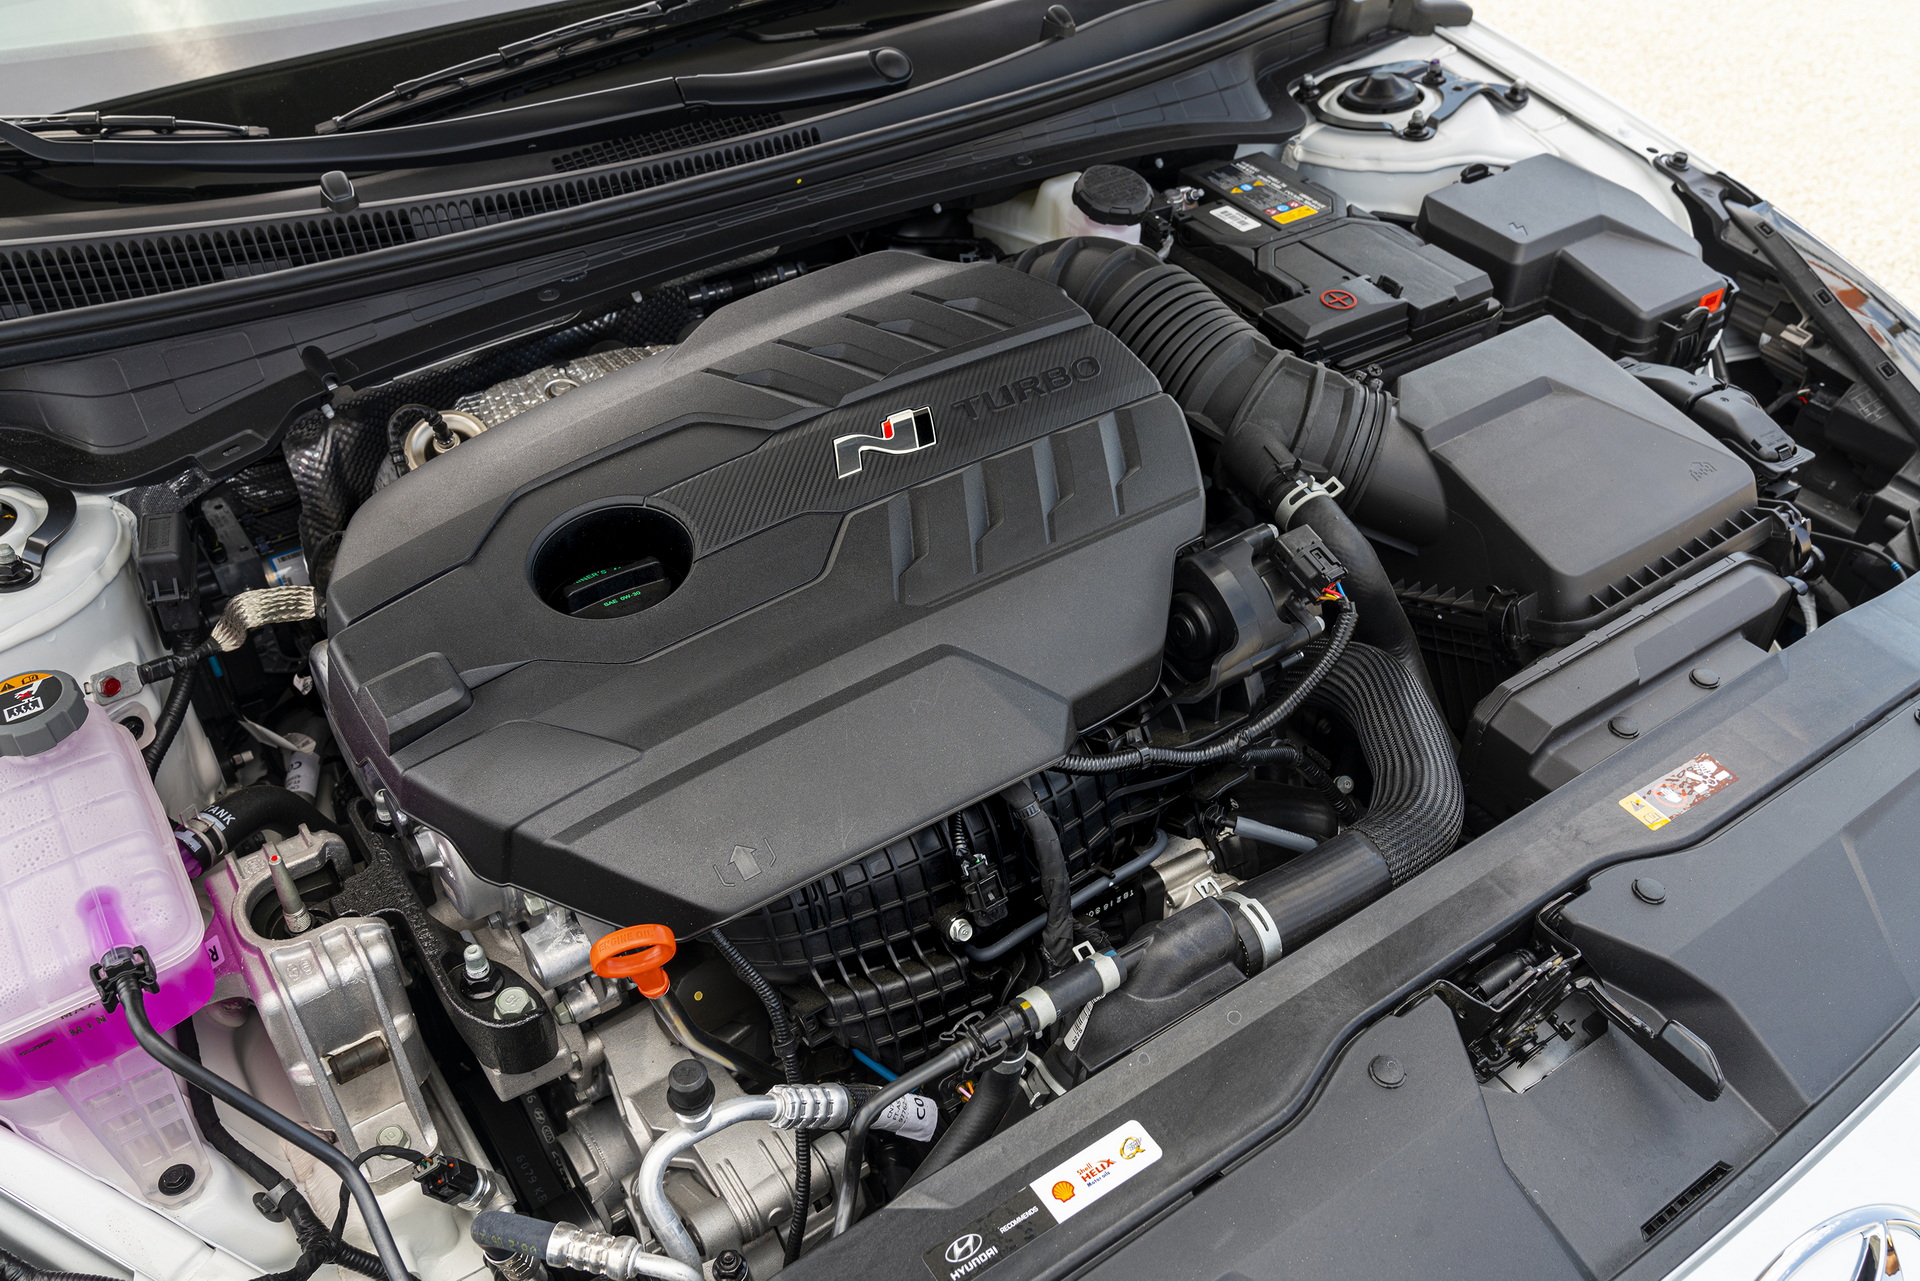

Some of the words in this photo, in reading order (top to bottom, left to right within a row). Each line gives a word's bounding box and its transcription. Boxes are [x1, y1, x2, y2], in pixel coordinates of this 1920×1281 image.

[951, 356, 1101, 421] TURBO
[603, 598, 619, 607] SAE
[598, 931, 634, 952] ENGINE
[636, 928, 655, 939] OIL
[69, 1014, 108, 1037] MIN
[1076, 1162, 1093, 1176] Shell
[1081, 1158, 1116, 1182] HELIX
[1086, 1177, 1102, 1188] Motor
[1000, 1205, 1039, 1234] RECOMMENDS
[950, 1245, 999, 1281] HYUNDAI
